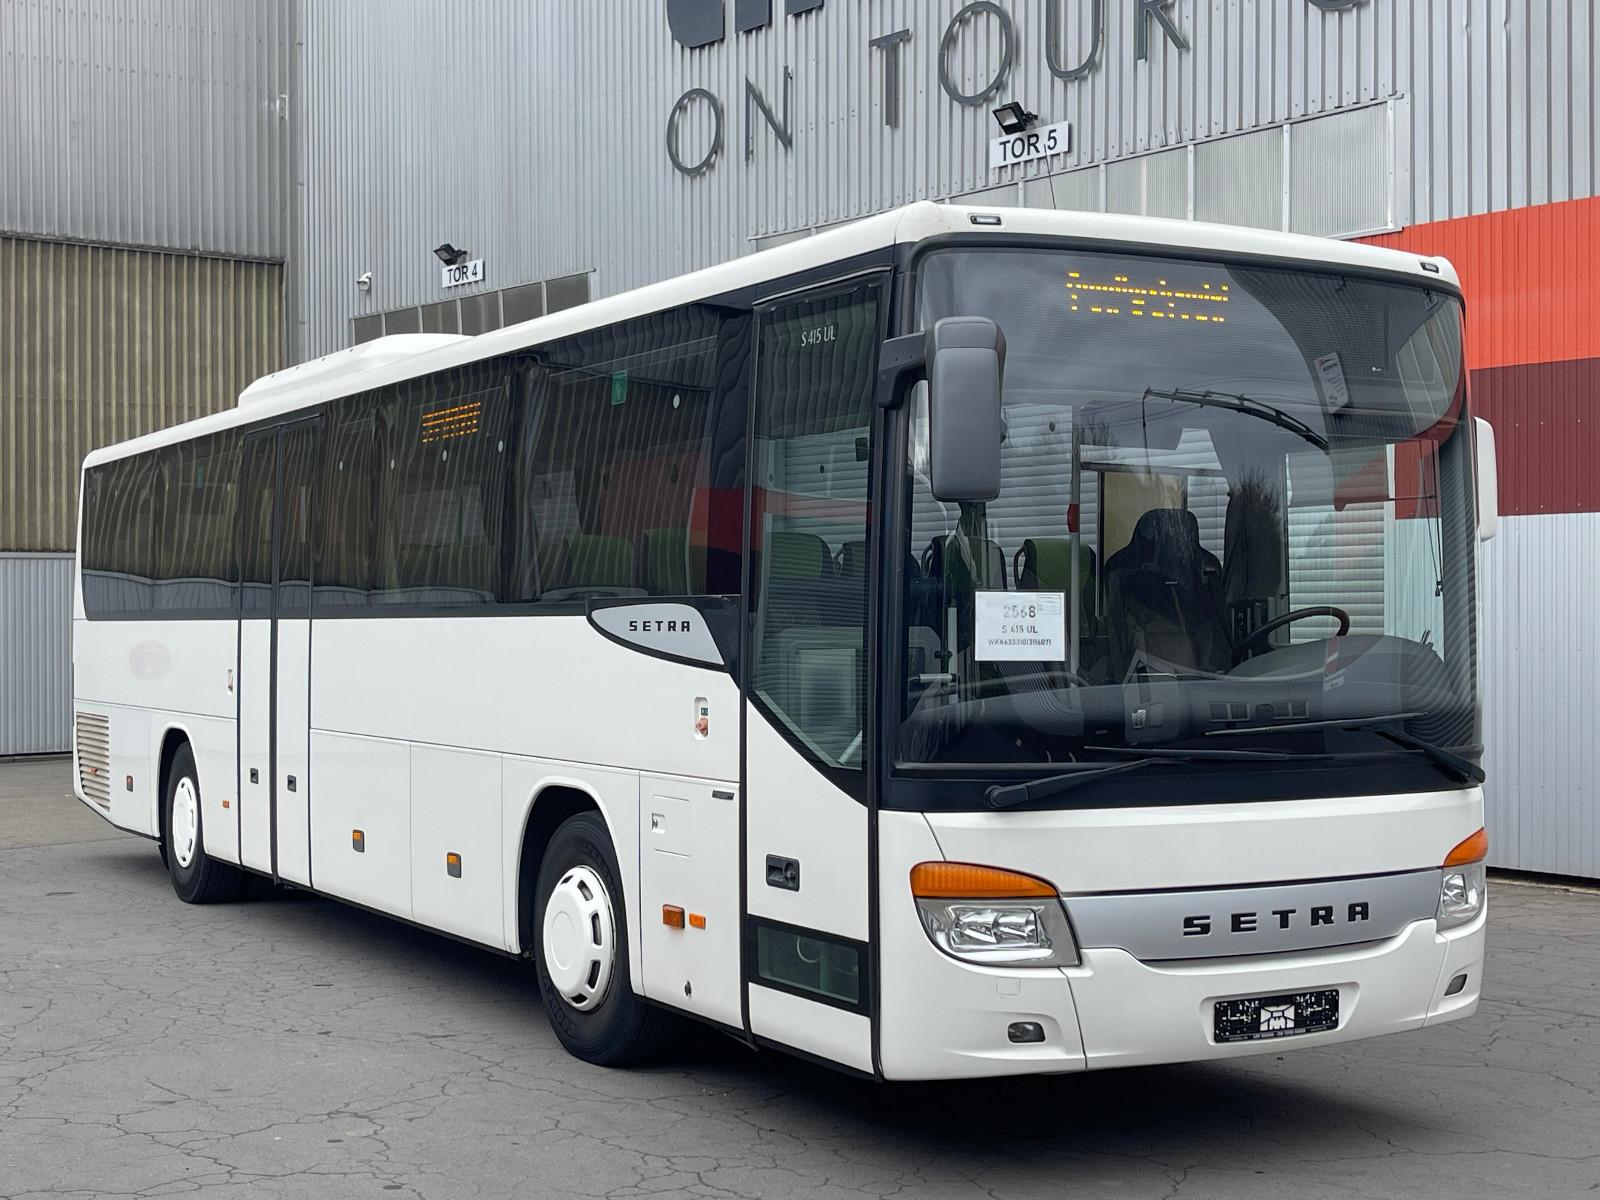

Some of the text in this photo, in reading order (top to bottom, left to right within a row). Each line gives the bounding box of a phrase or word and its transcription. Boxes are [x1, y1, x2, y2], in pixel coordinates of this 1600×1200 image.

[667, 66, 793, 175] ON
[869, 0, 1188, 127] TOUR
[999, 128, 1058, 161] TOR 5
[447, 262, 478, 284] TOR 4
[801, 325, 836, 347] S 415 UL
[1003, 604, 1036, 618] 2568
[629, 620, 691, 632] SETRA
[1001, 625, 1008, 634] S
[1026, 625, 1039, 634] UL
[1183, 901, 1370, 937] SETRA
